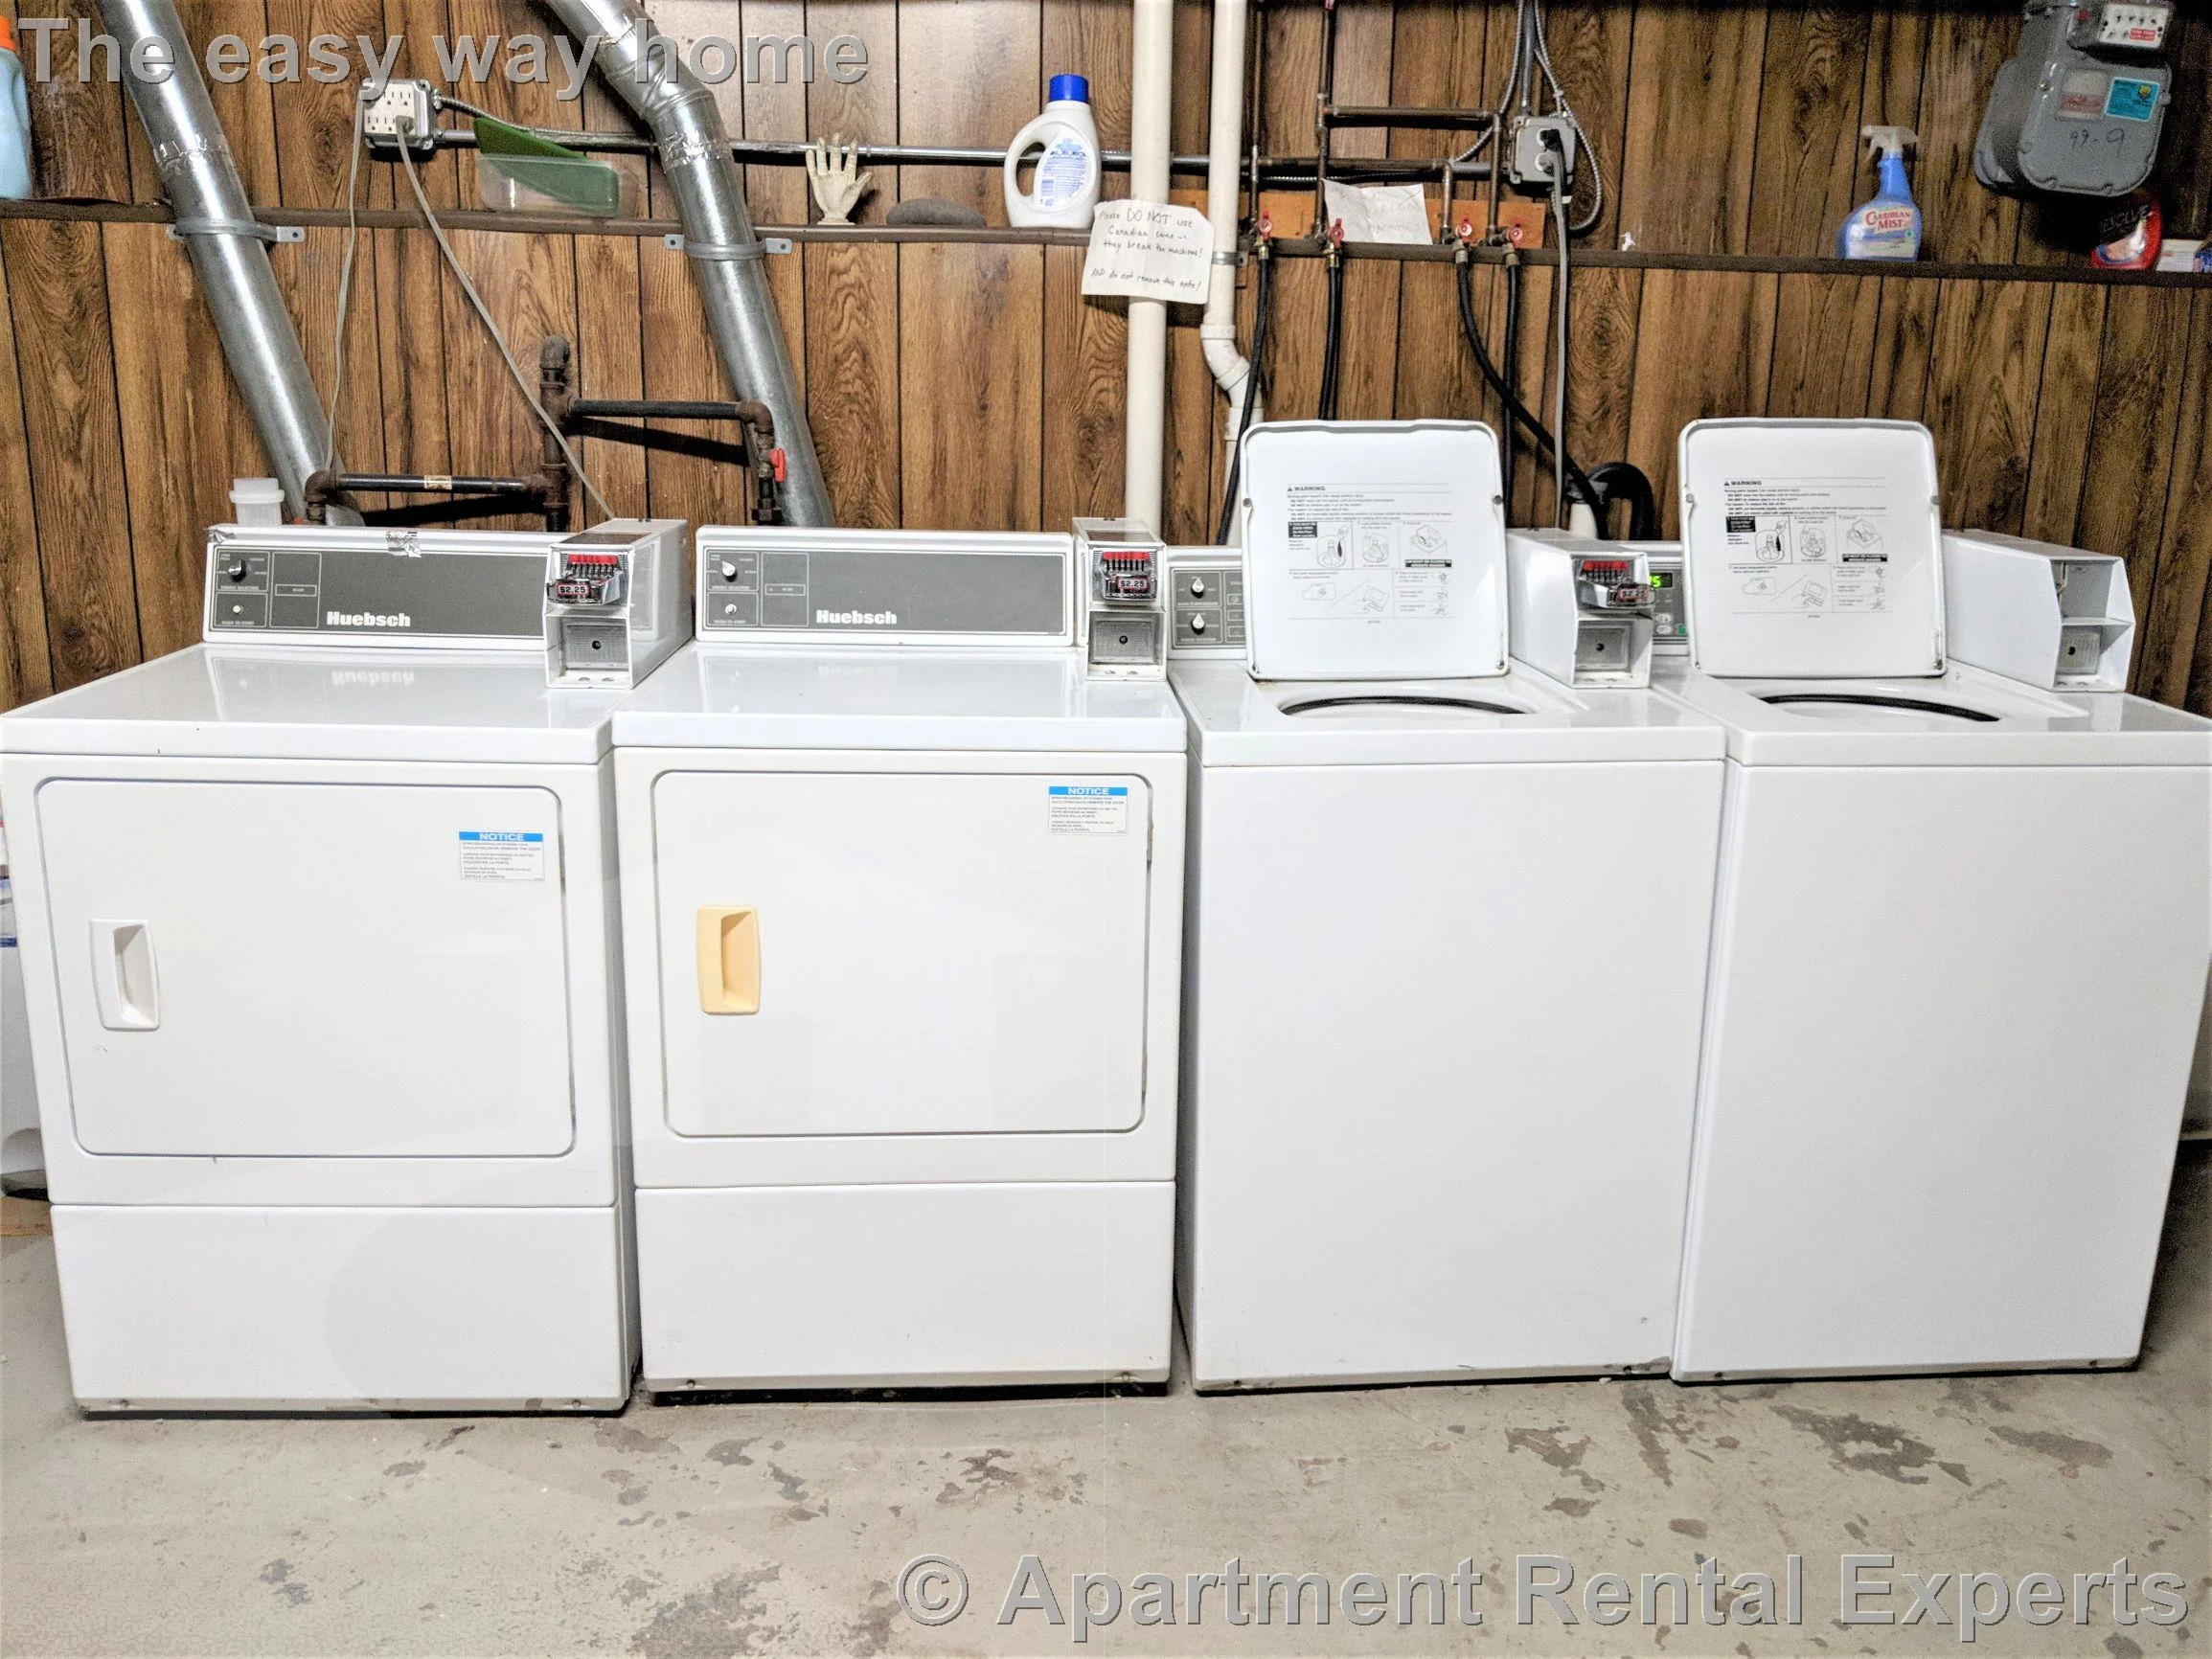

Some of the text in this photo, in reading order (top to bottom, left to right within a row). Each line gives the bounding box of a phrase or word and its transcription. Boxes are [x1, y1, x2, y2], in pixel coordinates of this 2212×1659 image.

[1127, 208, 1143, 222] DO
[1147, 211, 1172, 225] NOT
[1176, 218, 1193, 228] use
[1108, 225, 1149, 237] Canadian
[1878, 219, 1904, 231] MIST
[1104, 239, 1122, 254] they
[1128, 240, 1152, 250] break
[1121, 270, 1133, 280] not
[559, 584, 586, 594] $2.25
[1121, 580, 1145, 588] $2.25
[327, 611, 411, 626] Huebsch
[816, 609, 898, 625] Huebsch
[479, 832, 525, 841] NOTICE
